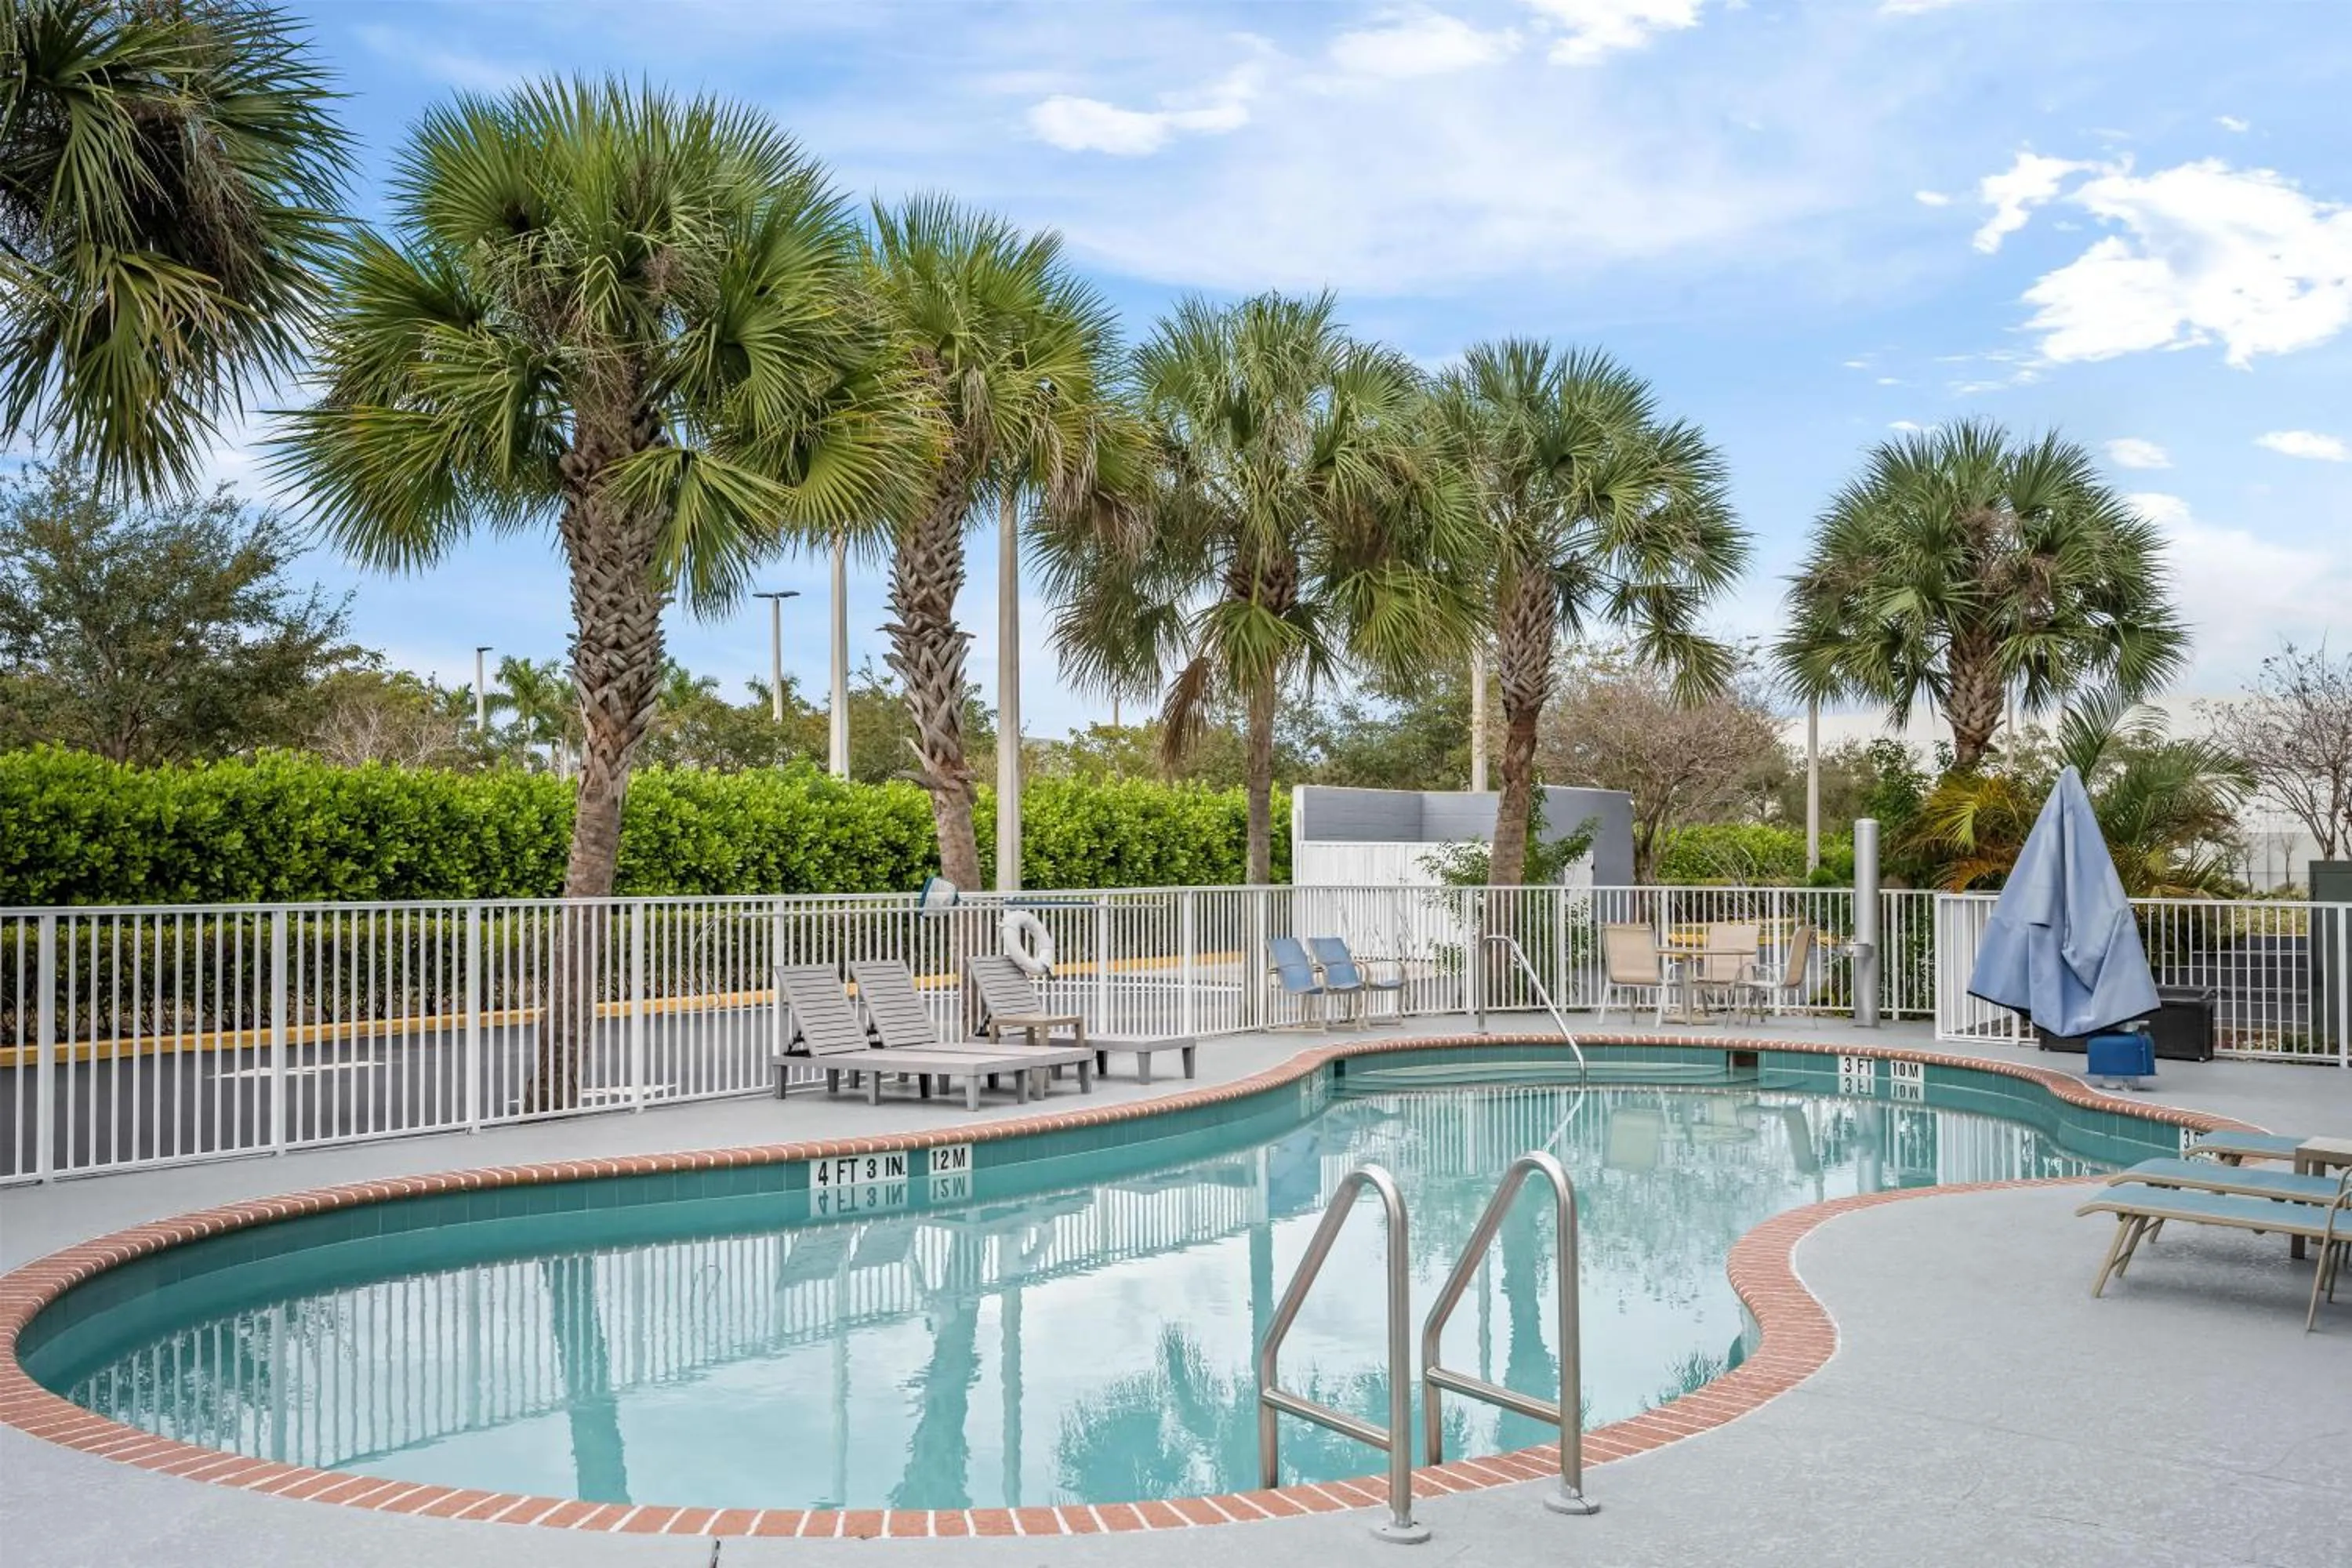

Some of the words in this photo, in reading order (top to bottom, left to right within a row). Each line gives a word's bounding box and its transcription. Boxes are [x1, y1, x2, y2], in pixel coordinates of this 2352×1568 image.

[1845, 1056, 1852, 1073] 3
[1857, 1058, 1873, 1076] FT
[2183, 1129, 2190, 1149] 3
[818, 1161, 829, 1186] 4
[837, 1158, 858, 1185] FT
[866, 1159, 877, 1179] 3
[885, 1155, 906, 1176] IN.
